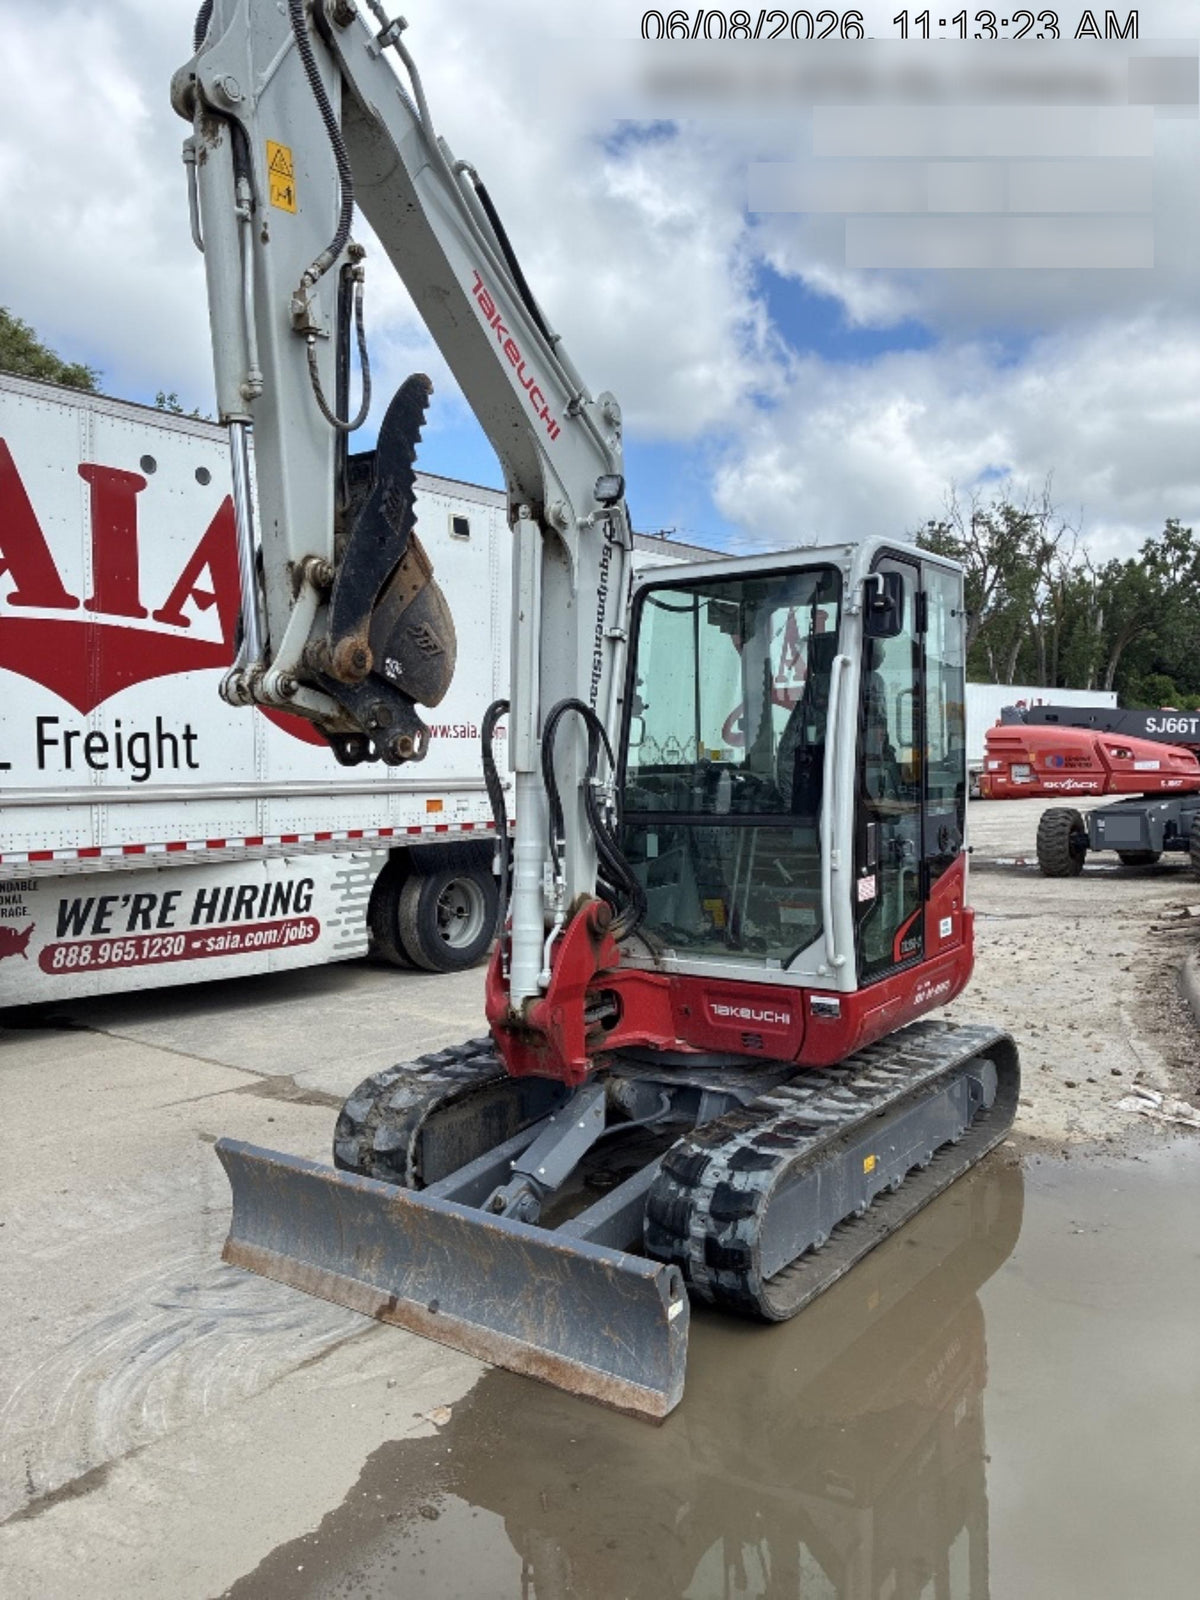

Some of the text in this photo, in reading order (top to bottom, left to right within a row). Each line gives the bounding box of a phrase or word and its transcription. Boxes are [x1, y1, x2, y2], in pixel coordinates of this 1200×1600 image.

[472, 269, 561, 441] TAKEUCHI
[588, 544, 613, 712] EquipmentShar
[36, 715, 199, 782] Freight
[1145, 717, 1199, 734] SJ66T
[56, 878, 315, 938] WE'RE HIRING
[52, 935, 186, 968] 888.965.1230
[205, 921, 314, 953] saia.com/jobs
[710, 1003, 790, 1025] TAKEUCHI
